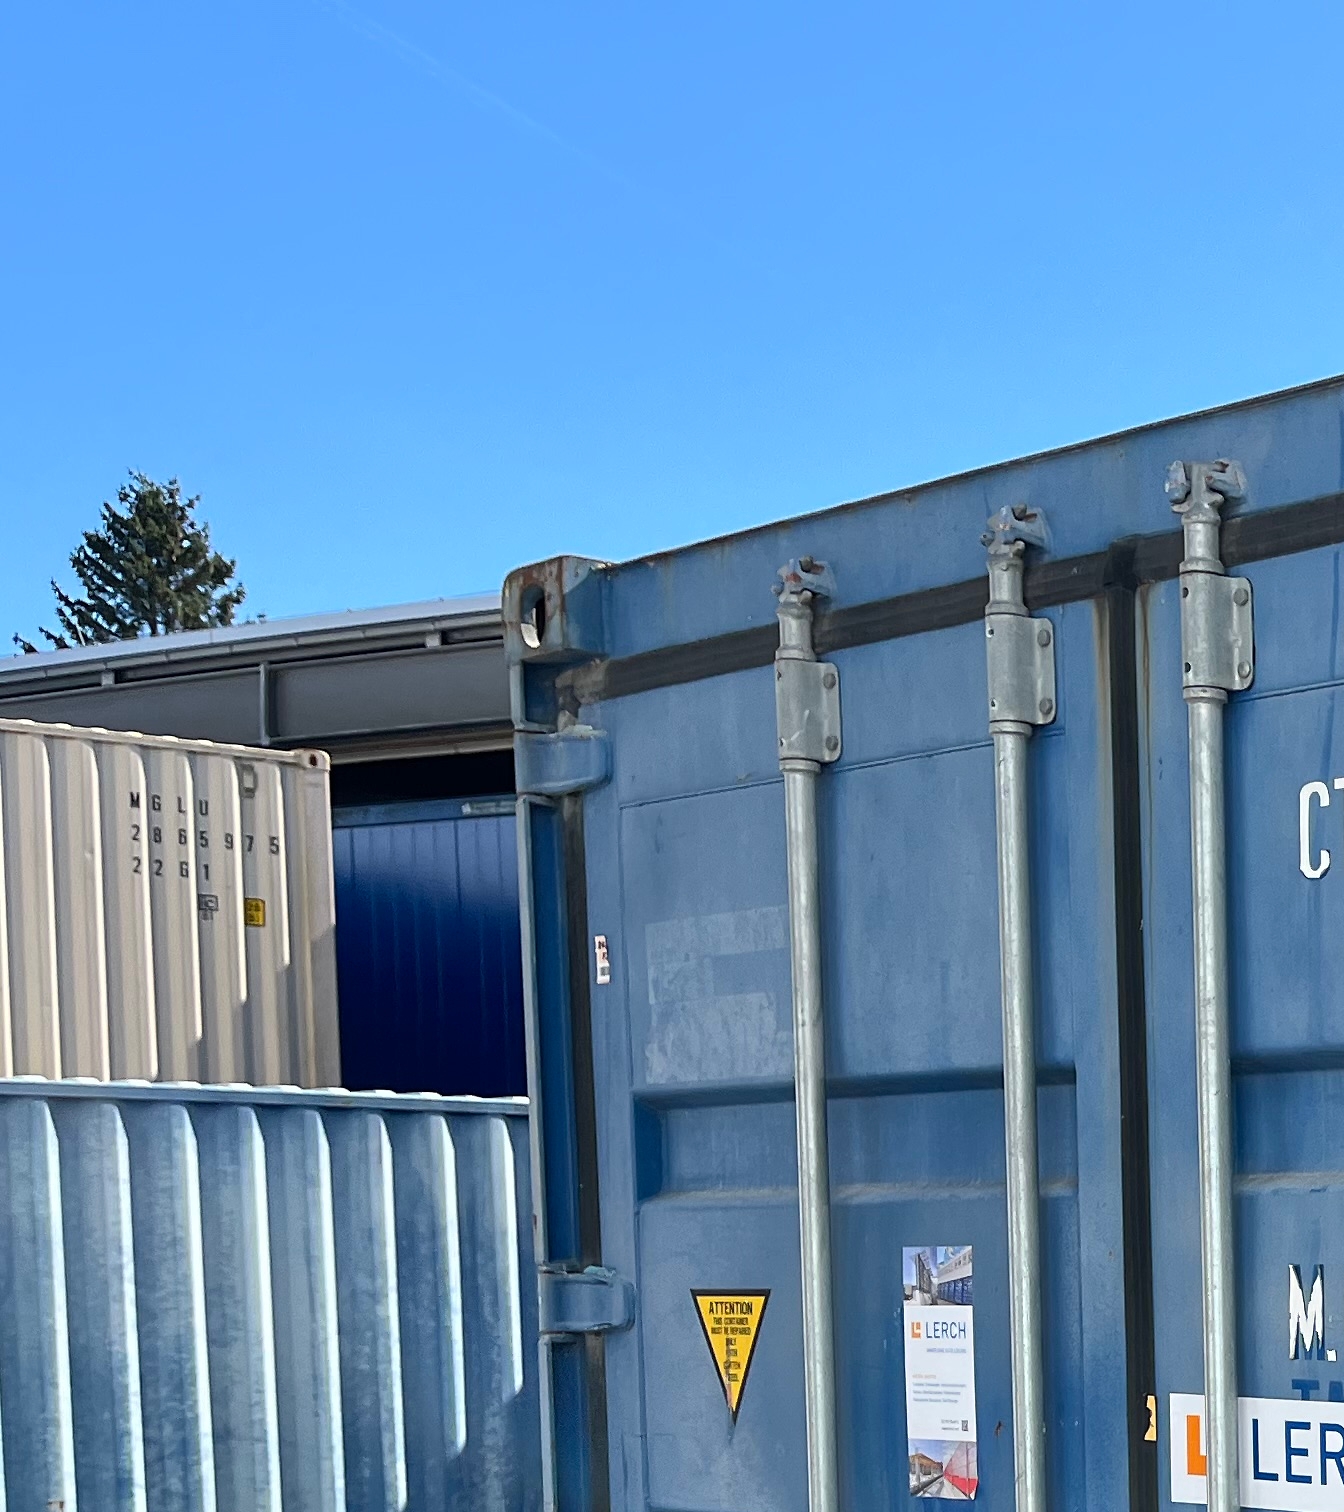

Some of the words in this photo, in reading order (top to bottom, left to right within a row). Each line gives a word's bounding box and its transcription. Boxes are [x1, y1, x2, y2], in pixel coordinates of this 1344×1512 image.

[132, 856, 210, 881] 22G1
[709, 1301, 753, 1315] ATTENTION
[926, 1321, 967, 1339] LERCH
